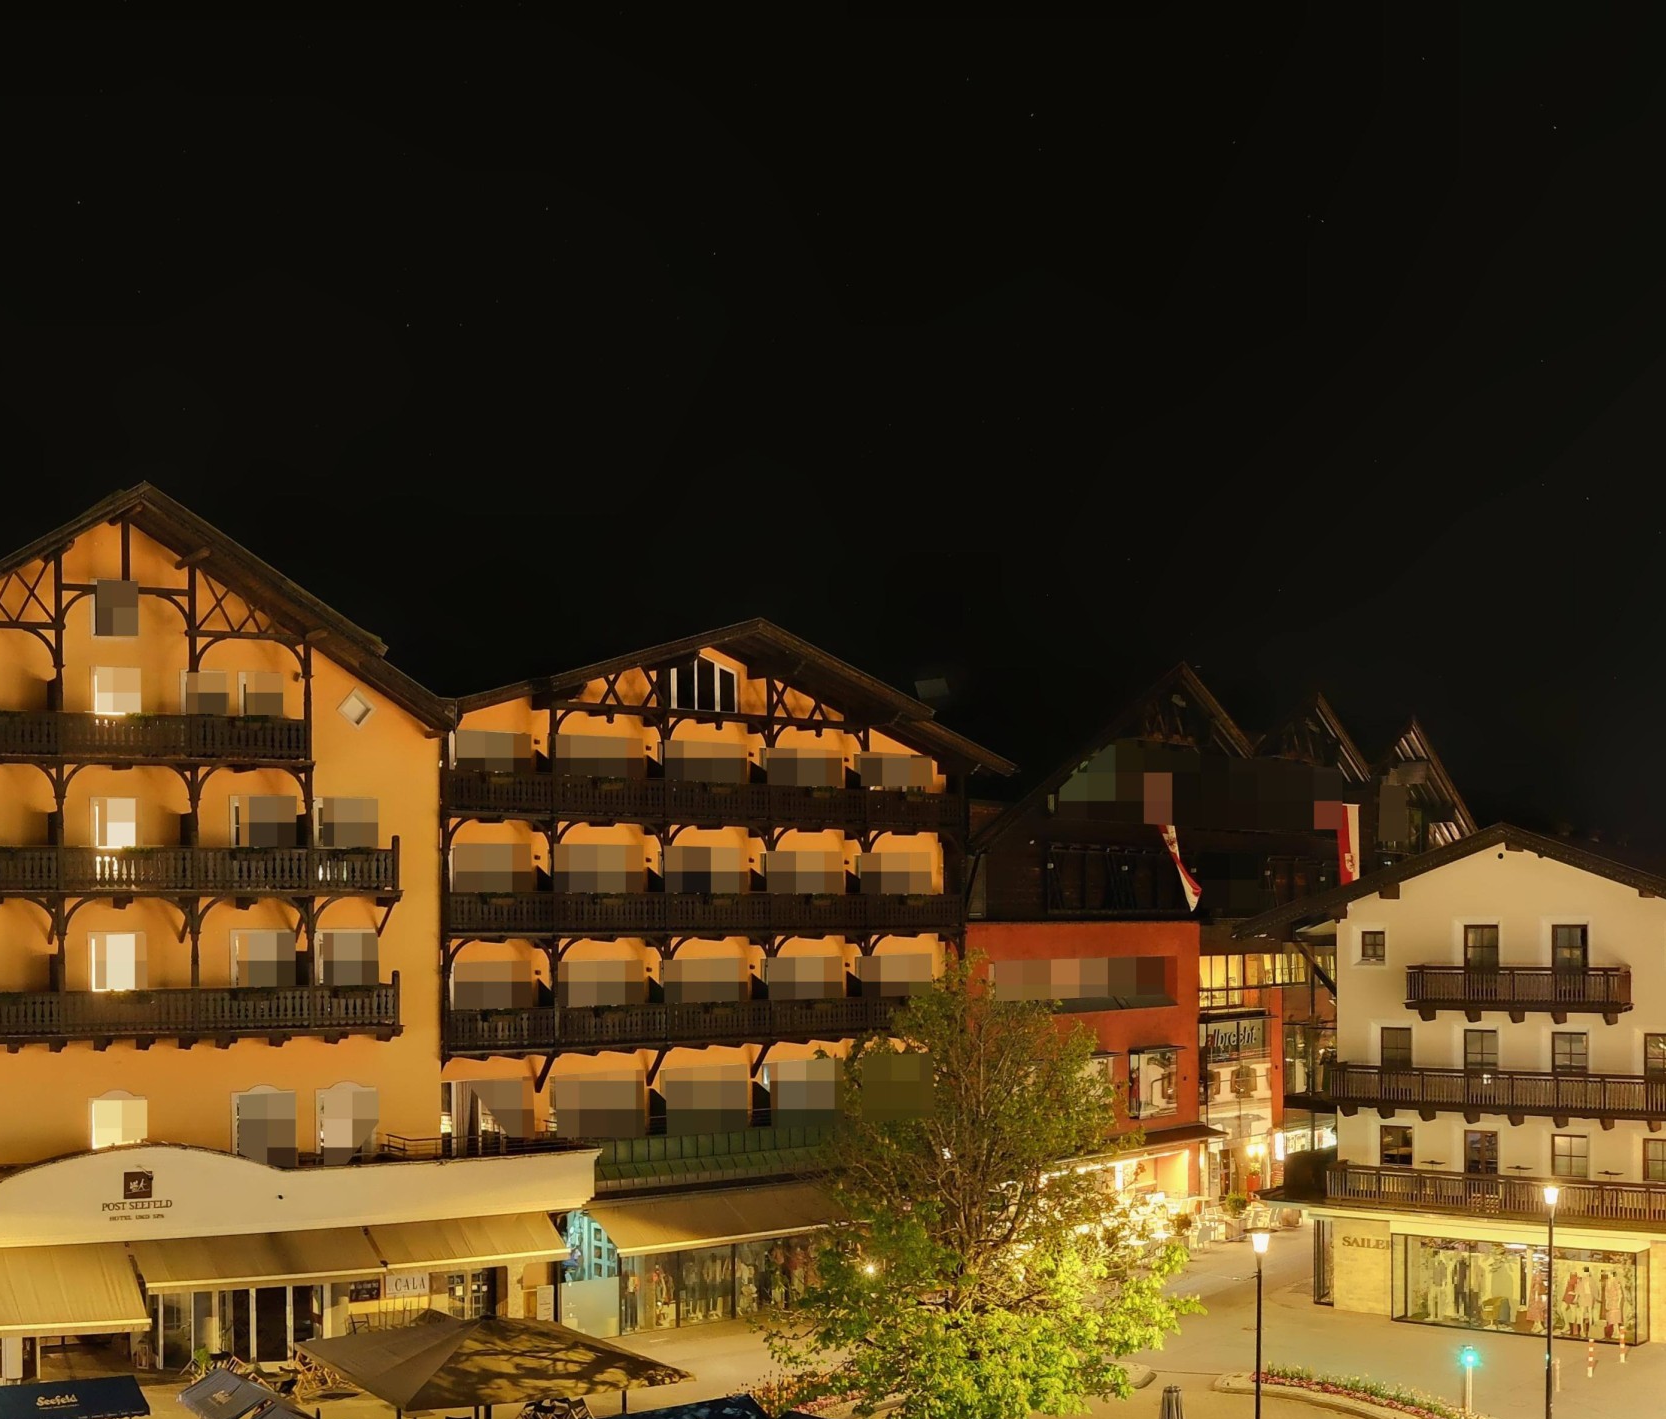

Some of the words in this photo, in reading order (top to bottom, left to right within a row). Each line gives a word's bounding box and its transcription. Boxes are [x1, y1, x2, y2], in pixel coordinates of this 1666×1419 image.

[1207, 1026, 1256, 1048] albrecht
[102, 1202, 127, 1212] POST
[129, 1199, 173, 1210] SEEFELD
[35, 1393, 79, 1408] Seefeld
